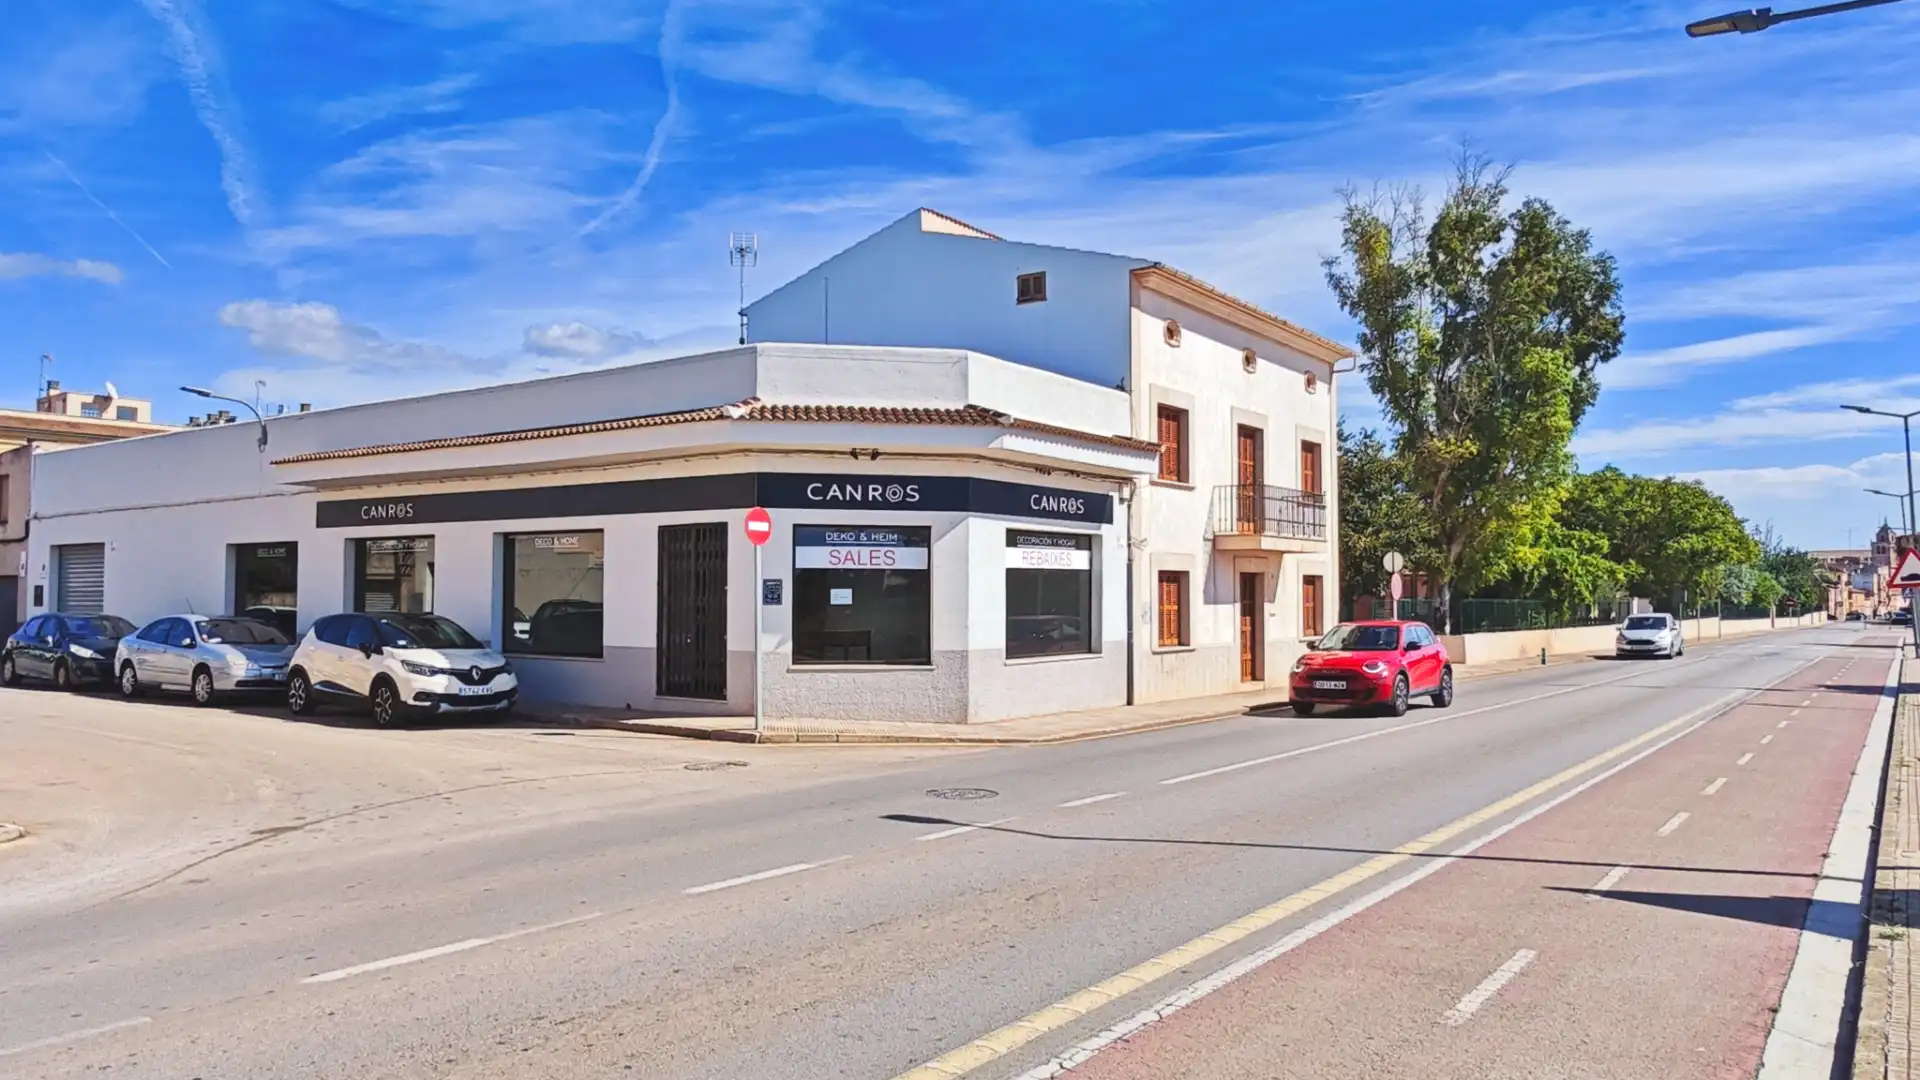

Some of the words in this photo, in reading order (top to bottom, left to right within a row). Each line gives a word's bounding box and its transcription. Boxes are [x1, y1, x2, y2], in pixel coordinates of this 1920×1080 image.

[807, 483, 920, 503] CANROS
[361, 503, 413, 519] CANROS
[1031, 494, 1085, 514] CANROS
[825, 532, 855, 541] DEKO
[860, 532, 867, 541] &
[871, 533, 898, 541] HEIM
[828, 549, 896, 566] SALES
[1022, 551, 1073, 567] REBAIXES
